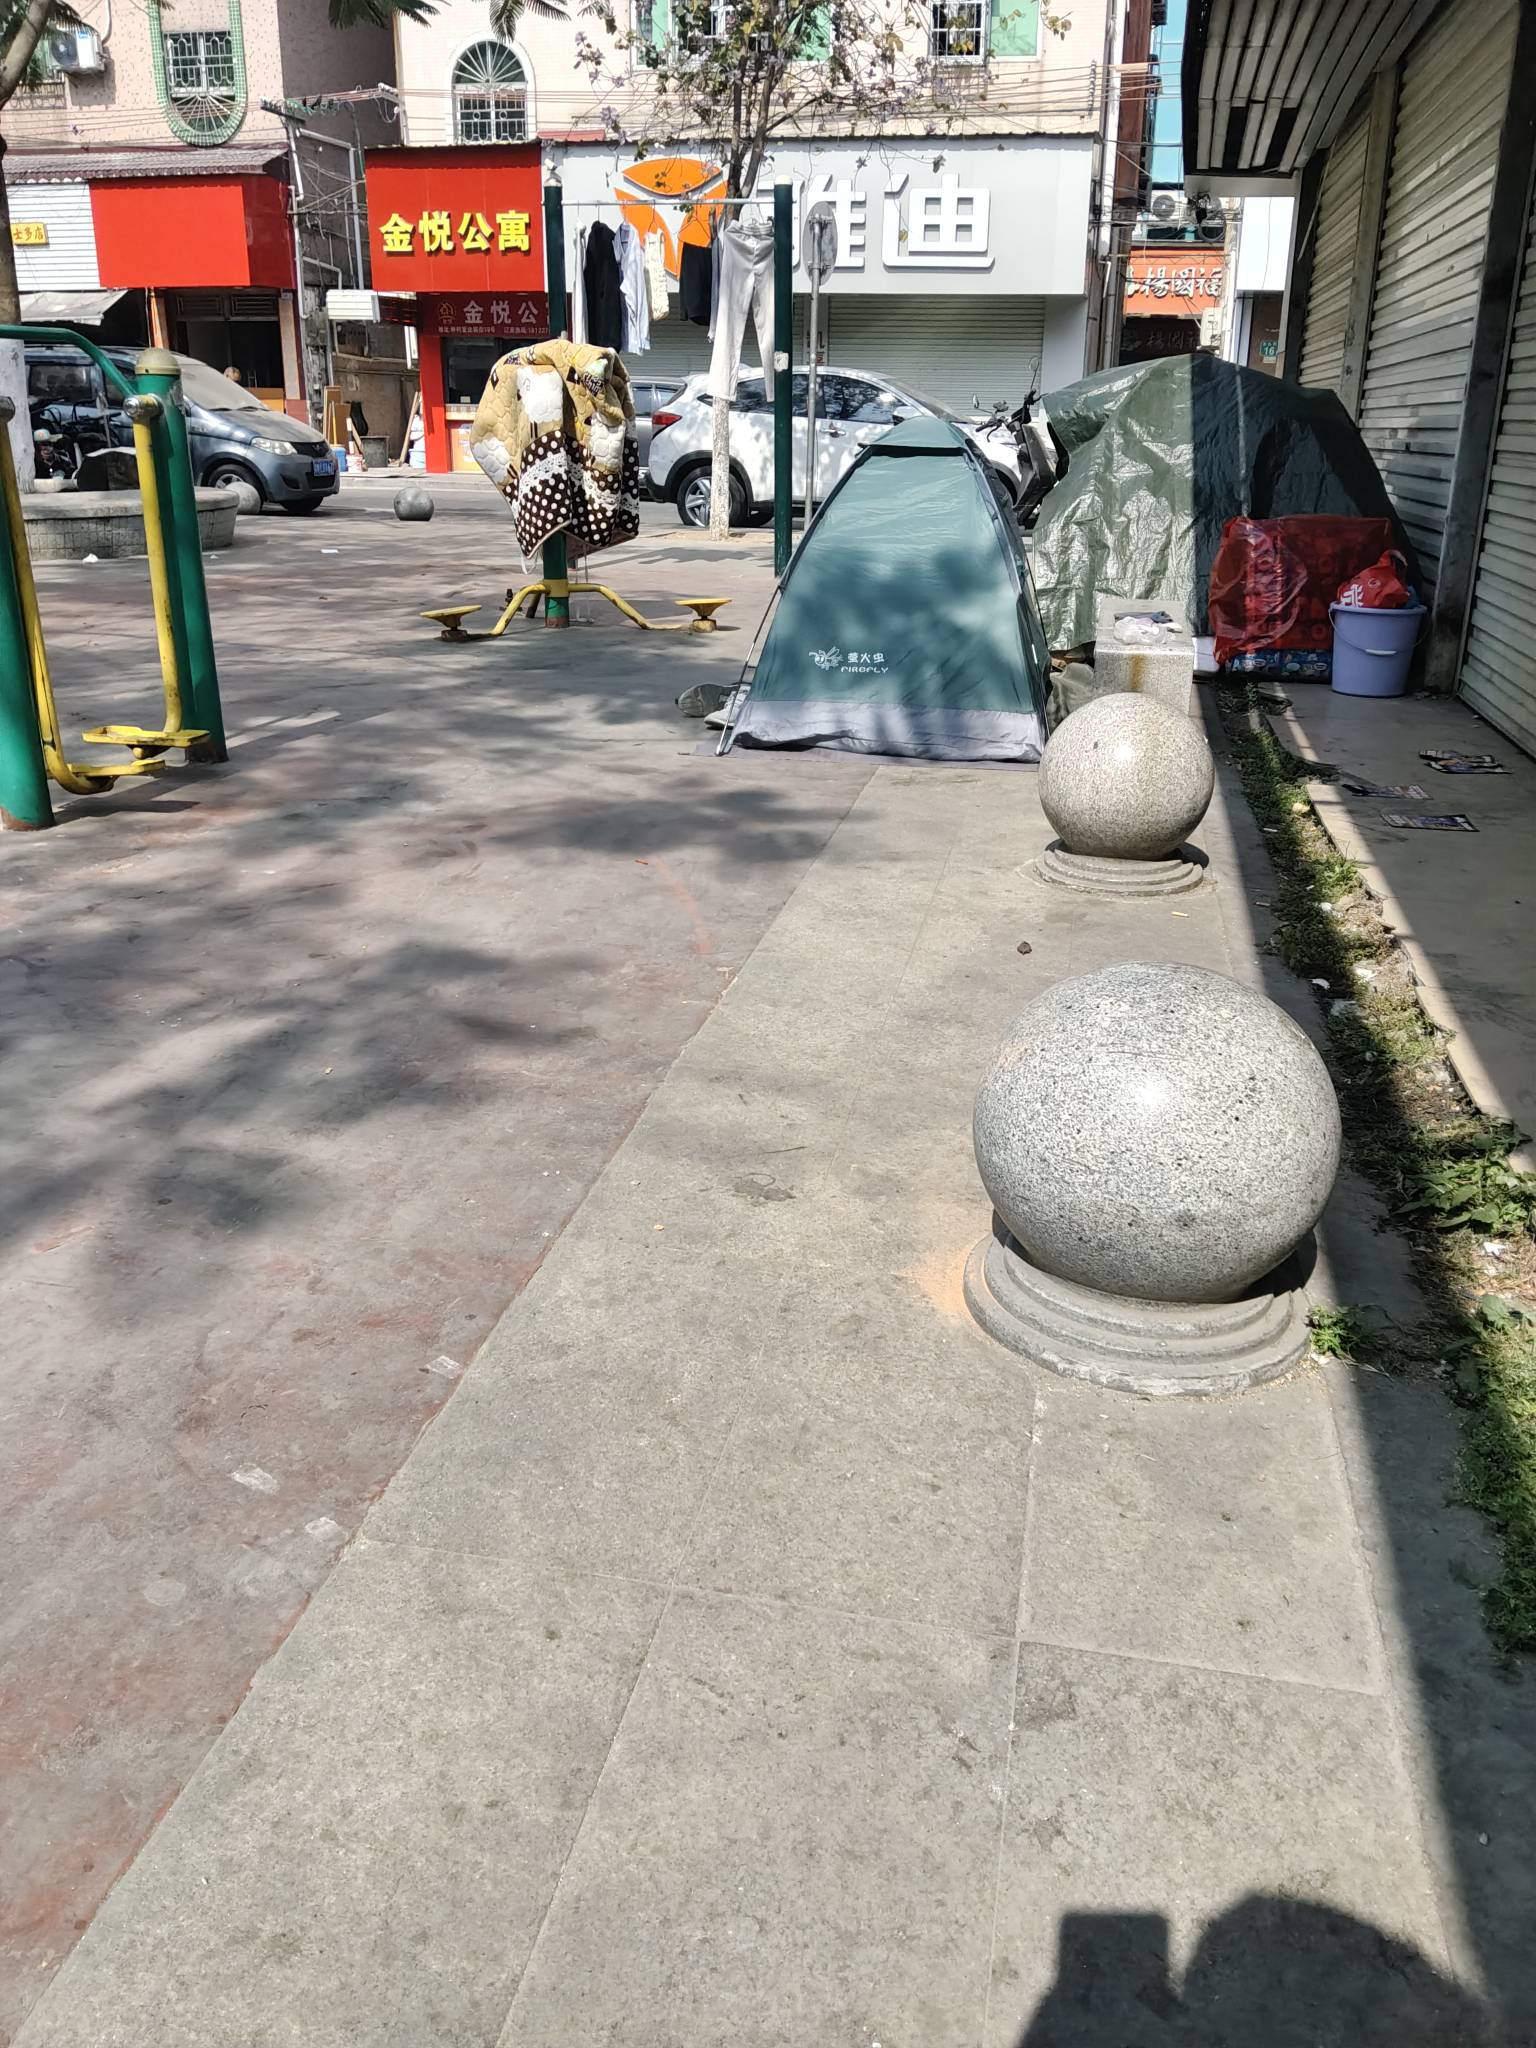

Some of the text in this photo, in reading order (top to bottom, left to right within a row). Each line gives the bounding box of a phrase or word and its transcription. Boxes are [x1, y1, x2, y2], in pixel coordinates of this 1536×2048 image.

[13, 226, 44, 241] 士多店
[379, 210, 531, 253] 金悦公寓
[463, 300, 549, 324] 金悦公
[1264, 346, 1275, 356] 16
[847, 652, 885, 664] 萤火虫
[840, 665, 889, 674] FIREFLY
